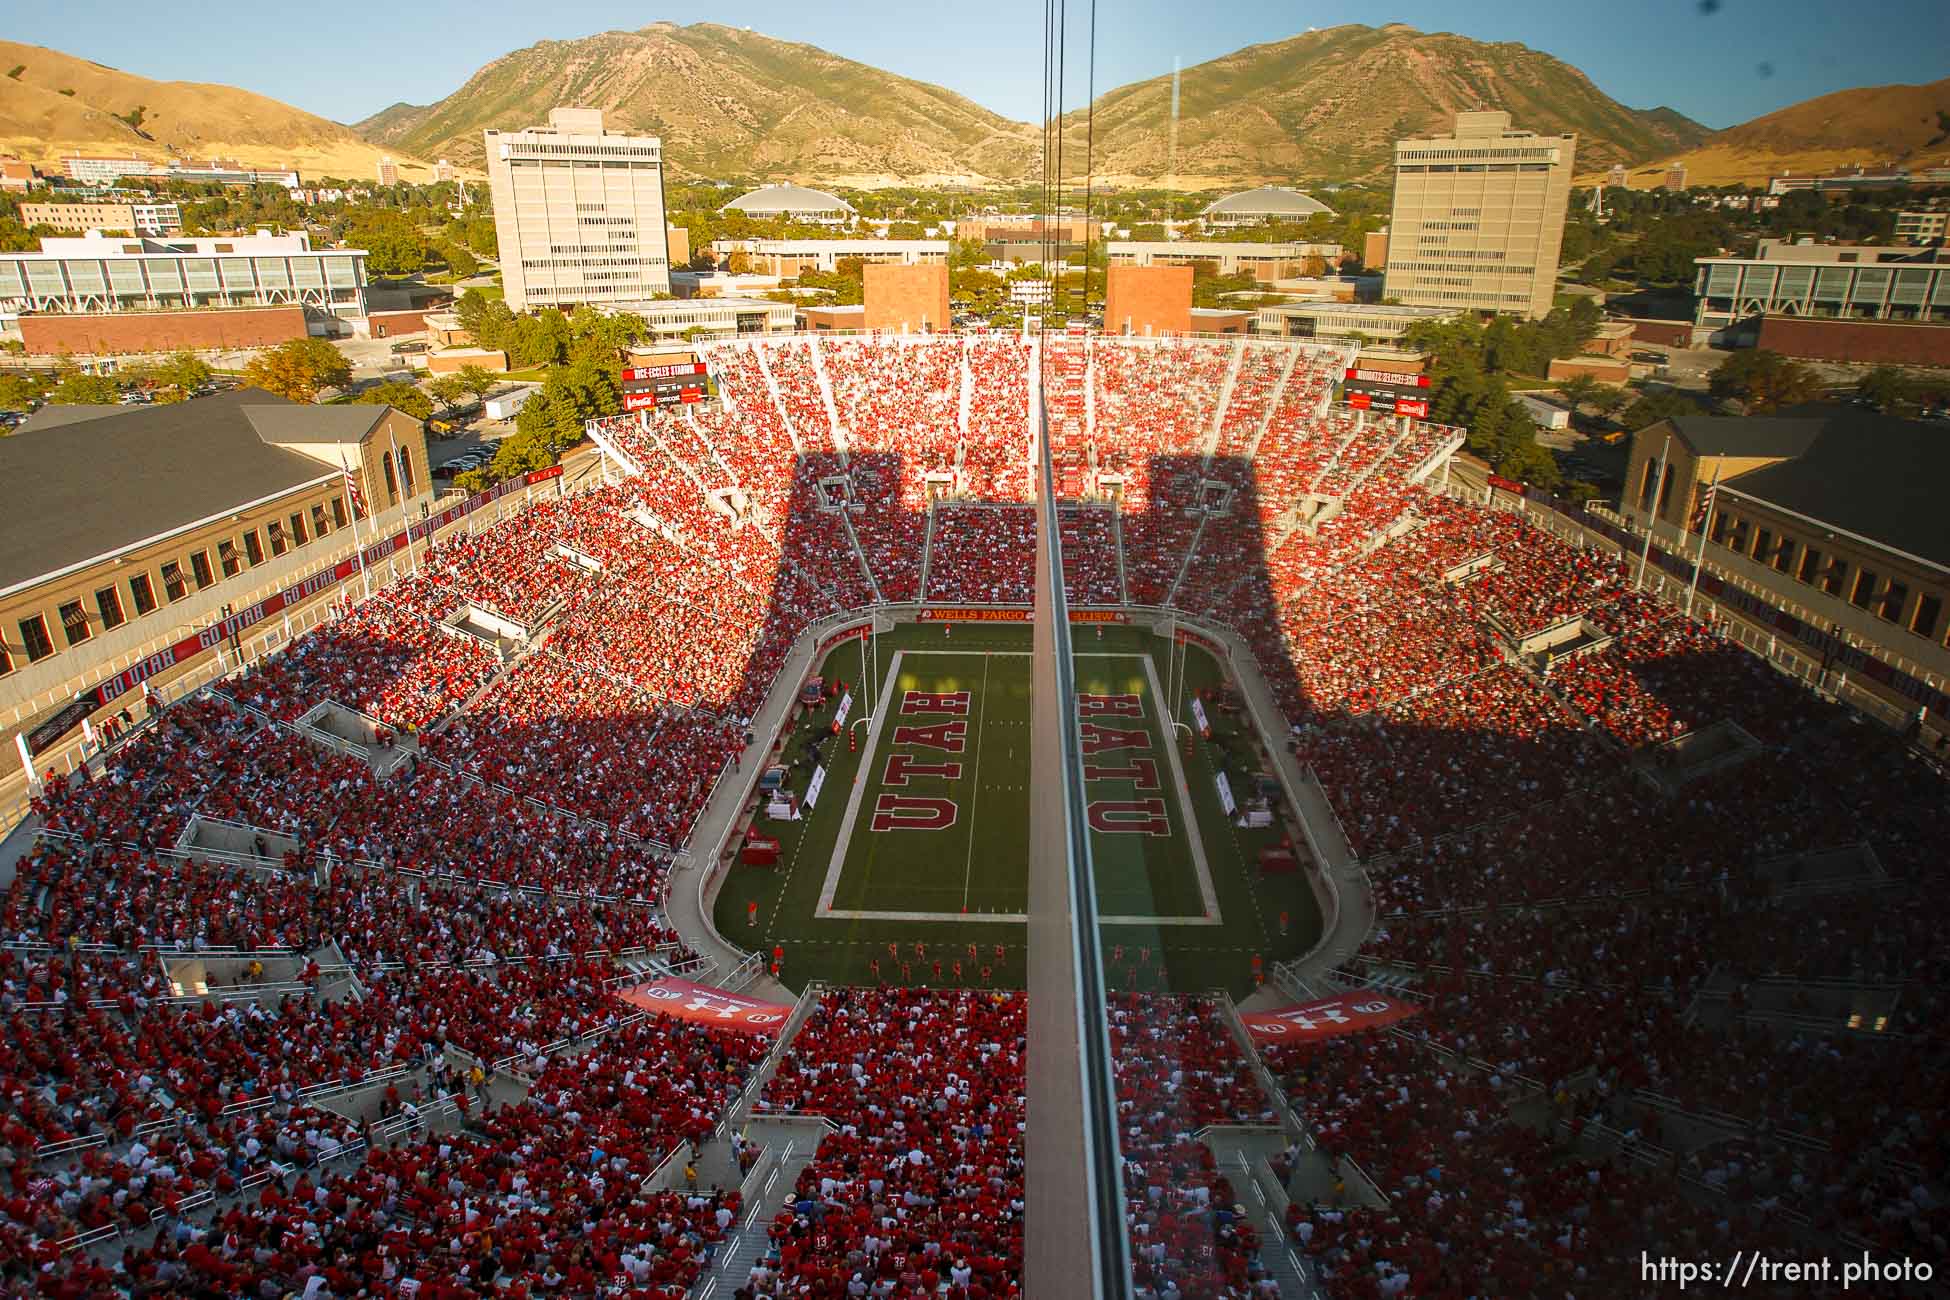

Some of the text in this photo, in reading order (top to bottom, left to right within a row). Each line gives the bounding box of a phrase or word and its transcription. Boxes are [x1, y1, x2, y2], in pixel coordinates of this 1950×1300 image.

[283, 566, 336, 606] GO UTAH
[933, 610, 1024, 620] WELLS FARGO
[200, 624, 221, 649] GO
[102, 648, 176, 703] GO UTAH
[870, 690, 972, 833] UTAH
[816, 1236, 827, 1247] 13
[614, 1275, 627, 1287] 32
